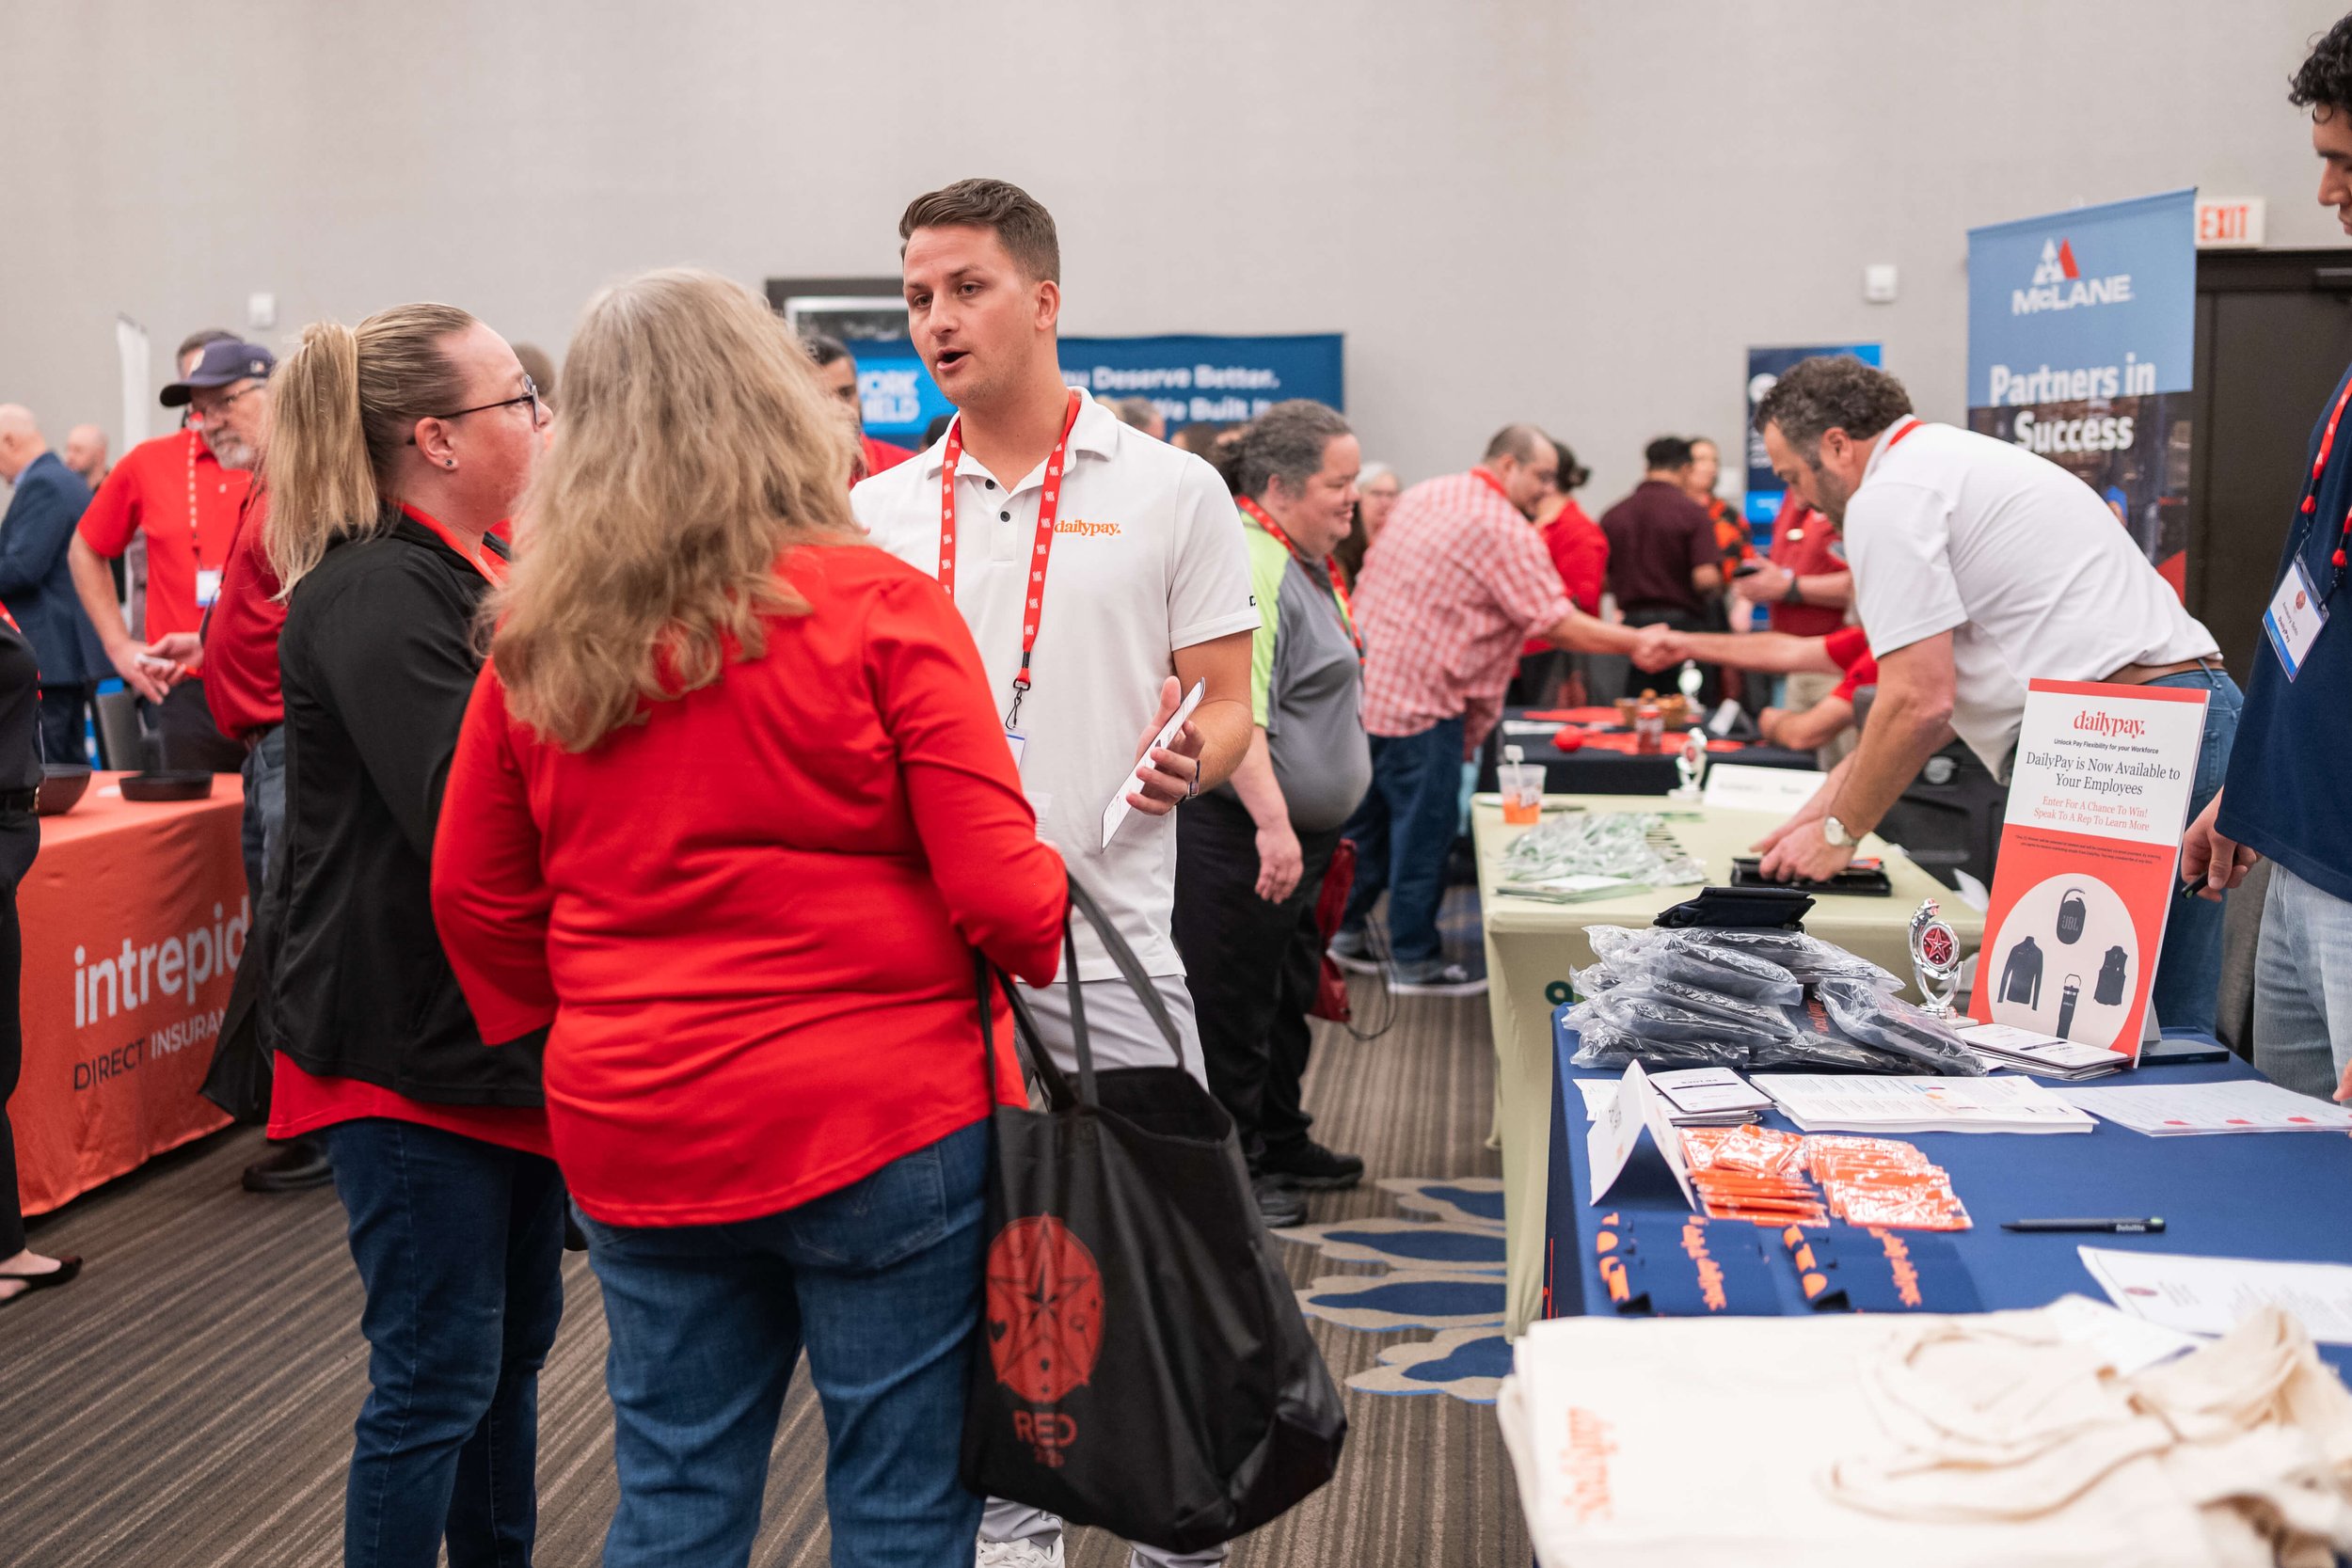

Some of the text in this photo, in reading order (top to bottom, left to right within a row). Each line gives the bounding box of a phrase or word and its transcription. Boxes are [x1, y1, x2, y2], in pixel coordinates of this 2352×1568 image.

[2200, 205, 2249, 240] EXIT
[1990, 351, 2156, 407] Partners in
[2014, 410, 2134, 454] Success
[2083, 741, 2108, 751] Flexibility
[2131, 745, 2159, 754] Workforce
[2026, 752, 2181, 780] DailyPay is Now Available to
[2056, 773, 2143, 796] Your Employees
[2034, 807, 2150, 832] Speak To A Rep To Learn More
[2042, 796, 2149, 818] Enter For A Chance To Win!
[74, 895, 250, 1029] intrepid
[73, 1037, 145, 1091] DIRECT
[1013, 1409, 1078, 1448] RED
